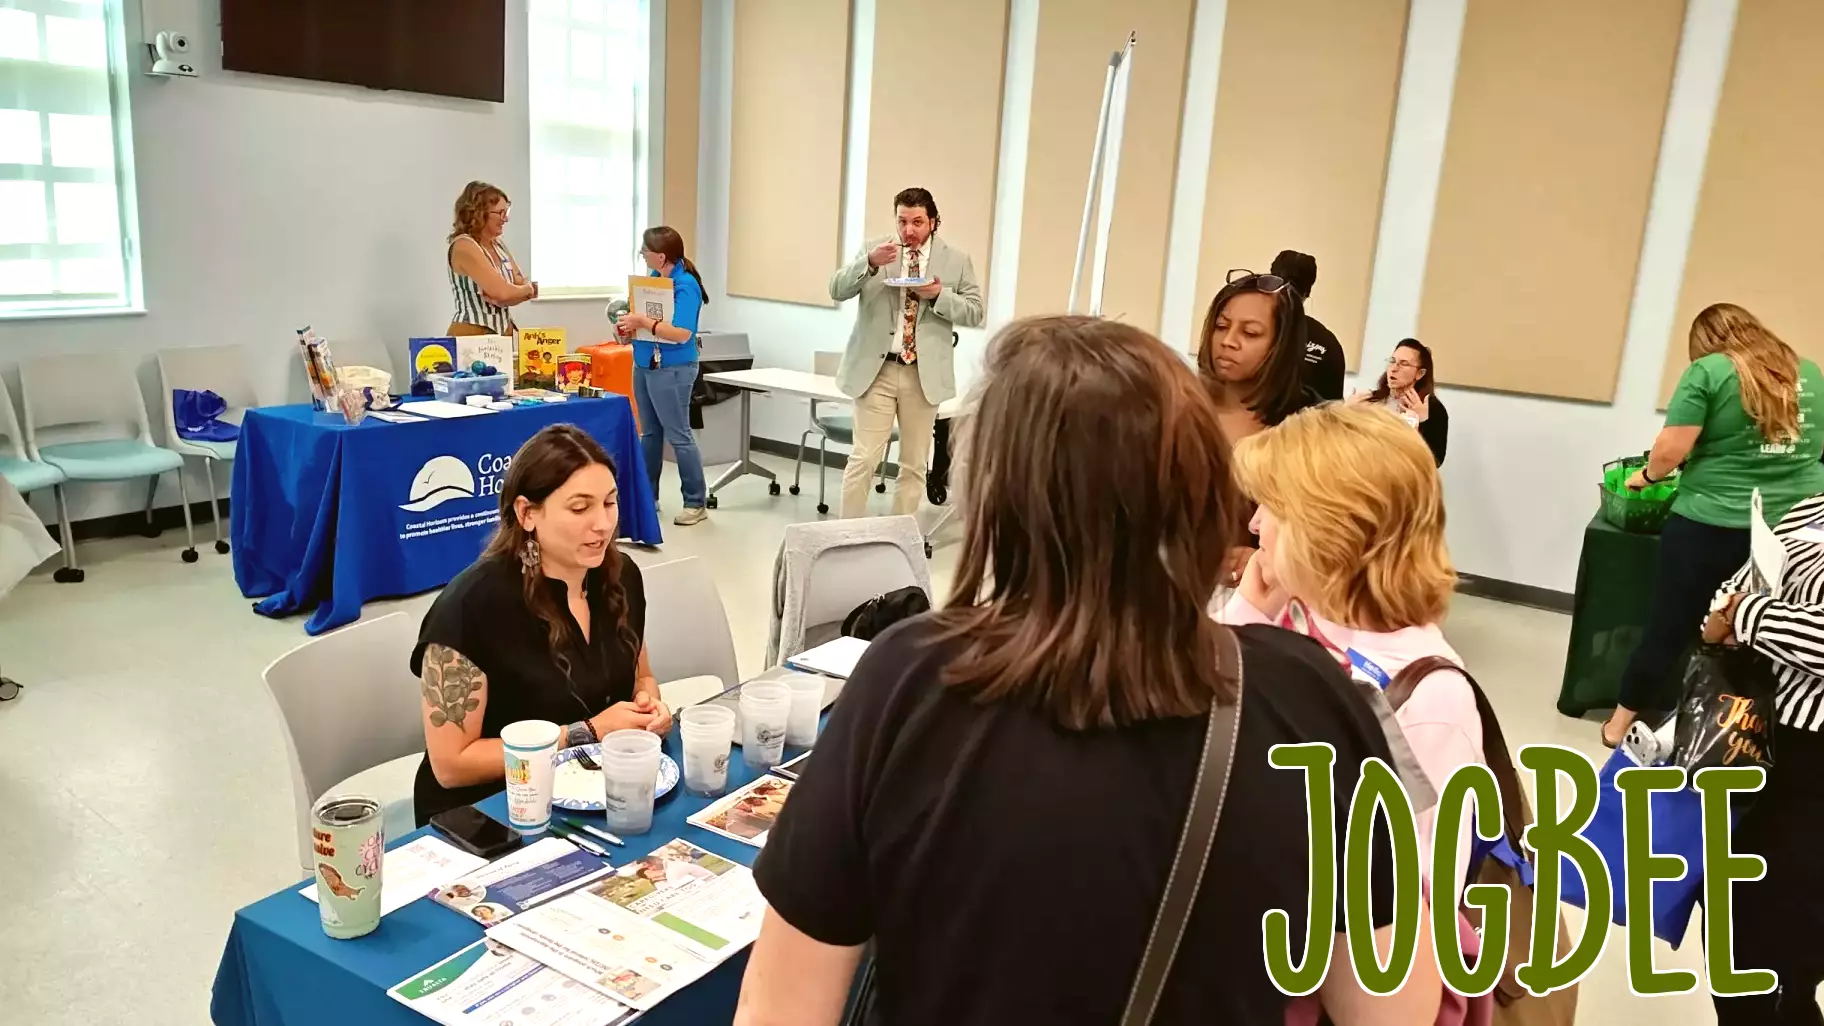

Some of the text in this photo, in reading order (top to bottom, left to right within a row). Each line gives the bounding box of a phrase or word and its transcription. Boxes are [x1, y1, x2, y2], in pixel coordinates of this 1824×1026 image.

[524, 332, 546, 341] Anh's
[537, 336, 562, 345] Anger
[405, 521, 426, 531] Coastal
[447, 513, 471, 524] provides
[405, 529, 429, 540] promote
[428, 525, 451, 535] healthier
[464, 518, 486, 528] stronger
